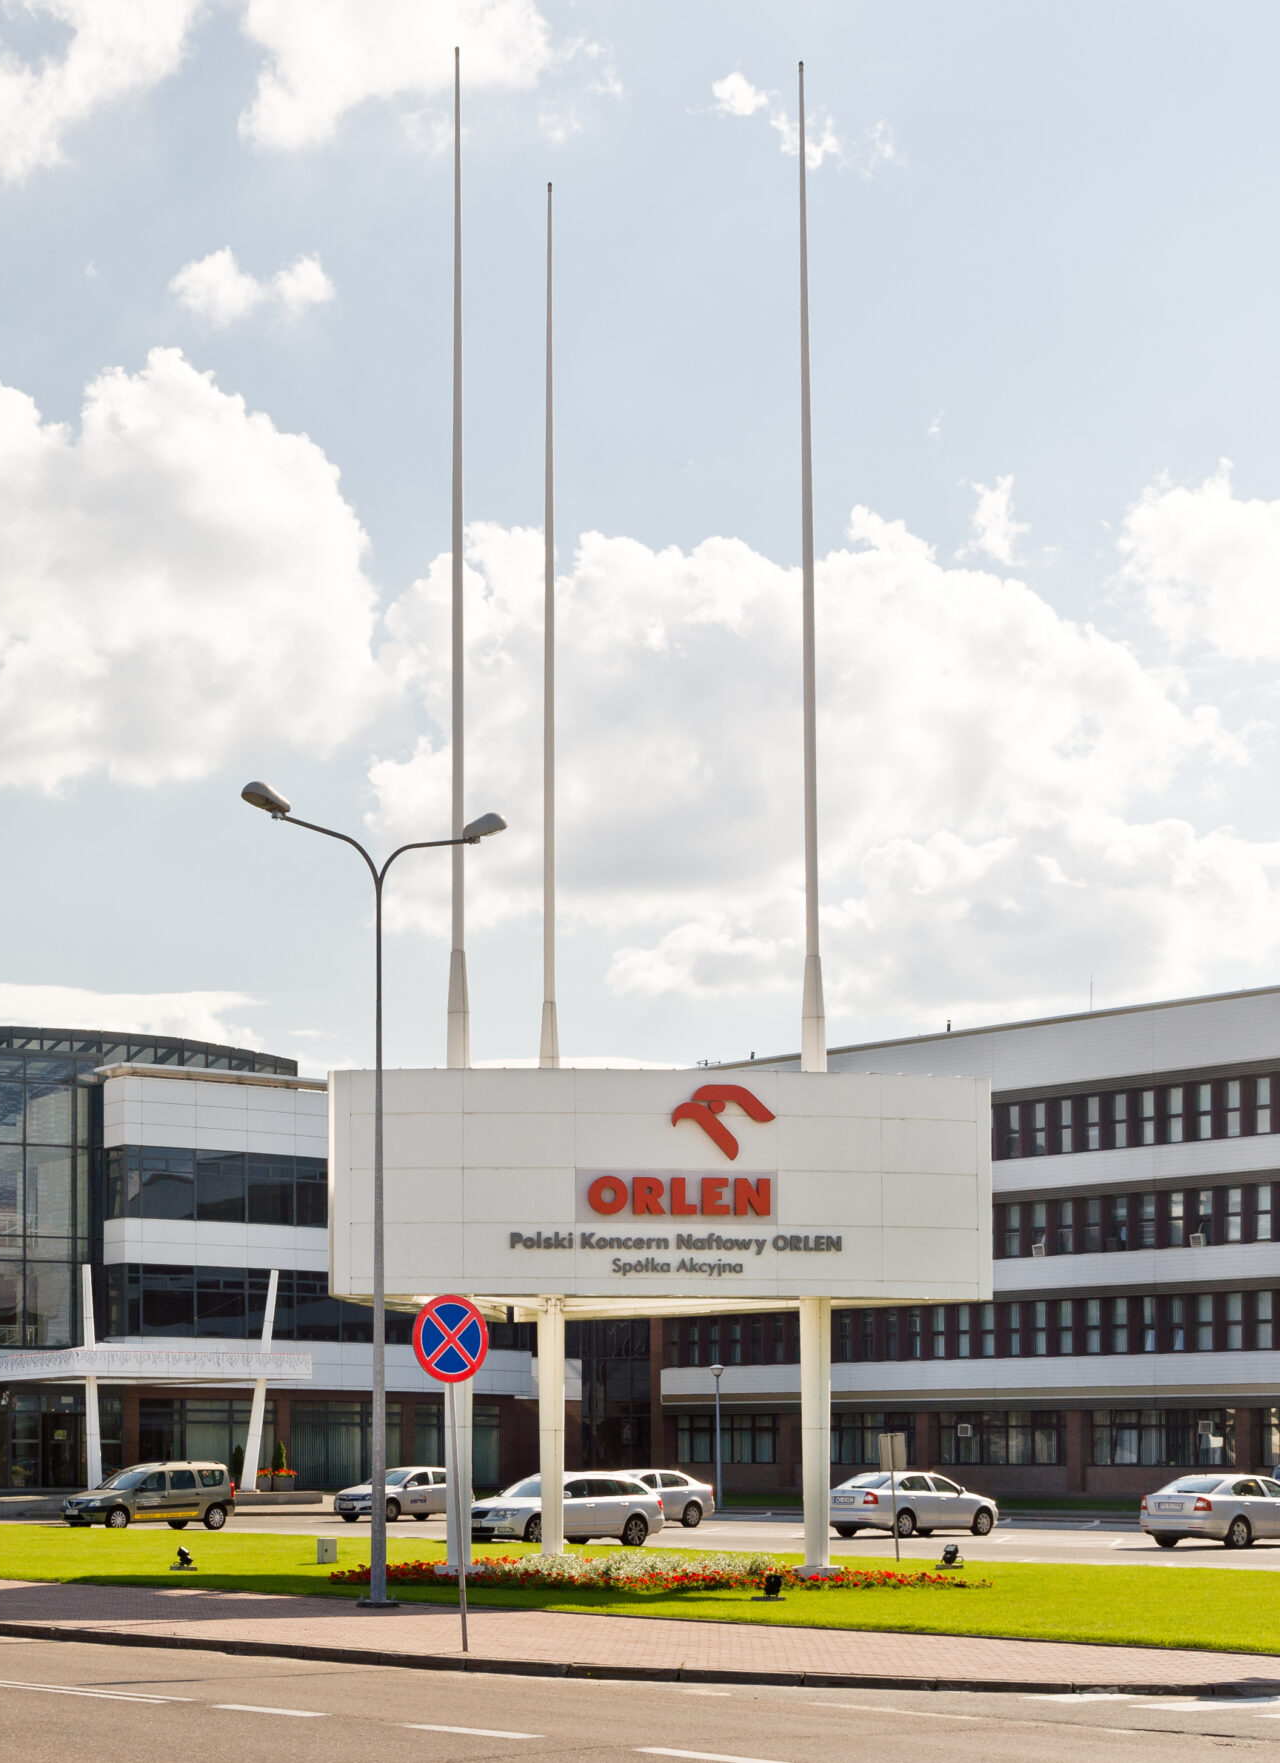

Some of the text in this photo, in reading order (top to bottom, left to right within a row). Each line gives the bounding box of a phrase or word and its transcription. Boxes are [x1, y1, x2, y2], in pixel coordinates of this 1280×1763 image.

[587, 1175, 771, 1216] ORLEN
[509, 1231, 843, 1256] Polski Koncern Naftowy ORLEN
[676, 1257, 744, 1277] Akcyjna
